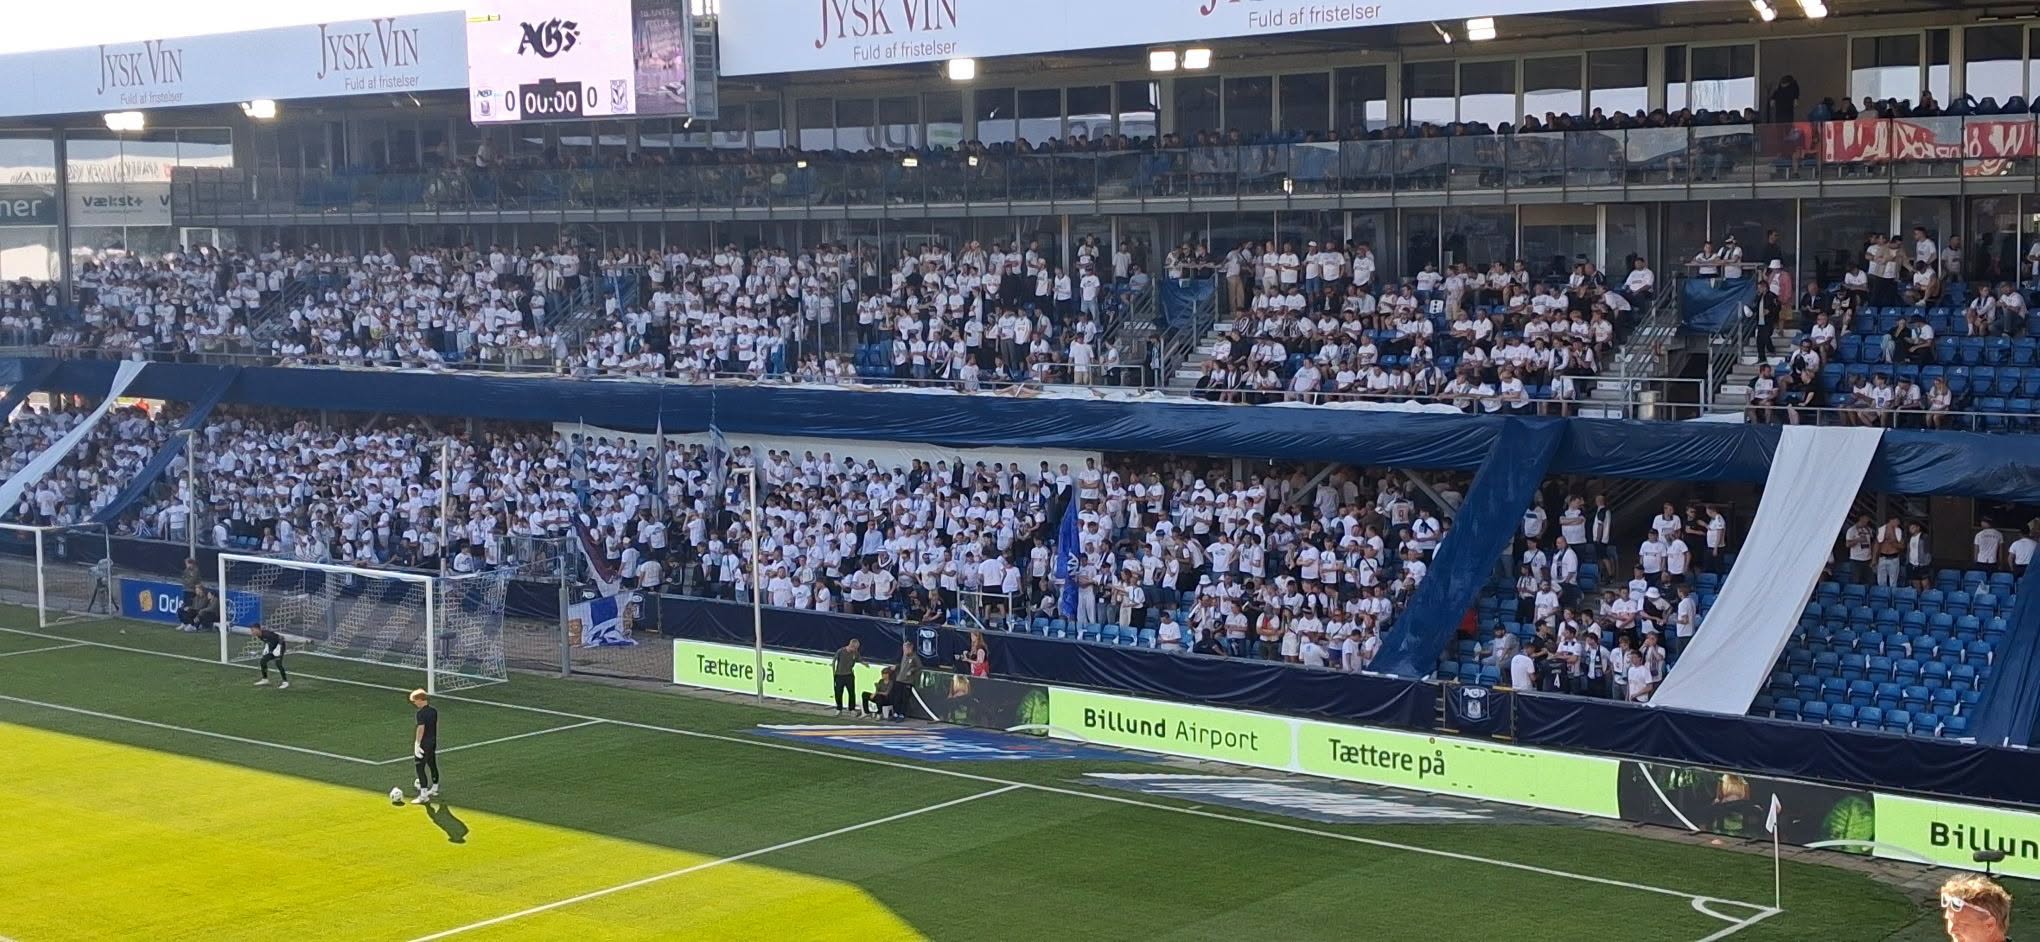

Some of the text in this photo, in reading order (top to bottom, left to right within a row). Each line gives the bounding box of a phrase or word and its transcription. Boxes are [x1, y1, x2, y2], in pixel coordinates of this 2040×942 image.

[1249, 3, 1382, 28] Fuld af fristelser
[317, 18, 420, 80] JYSK VIN
[854, 40, 957, 61] Fuld af fristelser
[97, 39, 183, 95] JYSK VIN
[345, 75, 420, 91] Fuld af fristelser
[505, 90, 516, 111] 0
[525, 90, 577, 114] 00:00
[587, 86, 598, 108] 0
[697, 654, 754, 680] Tættere
[1084, 708, 1258, 751] Billund Airport
[1328, 738, 1445, 779] Tættere på
